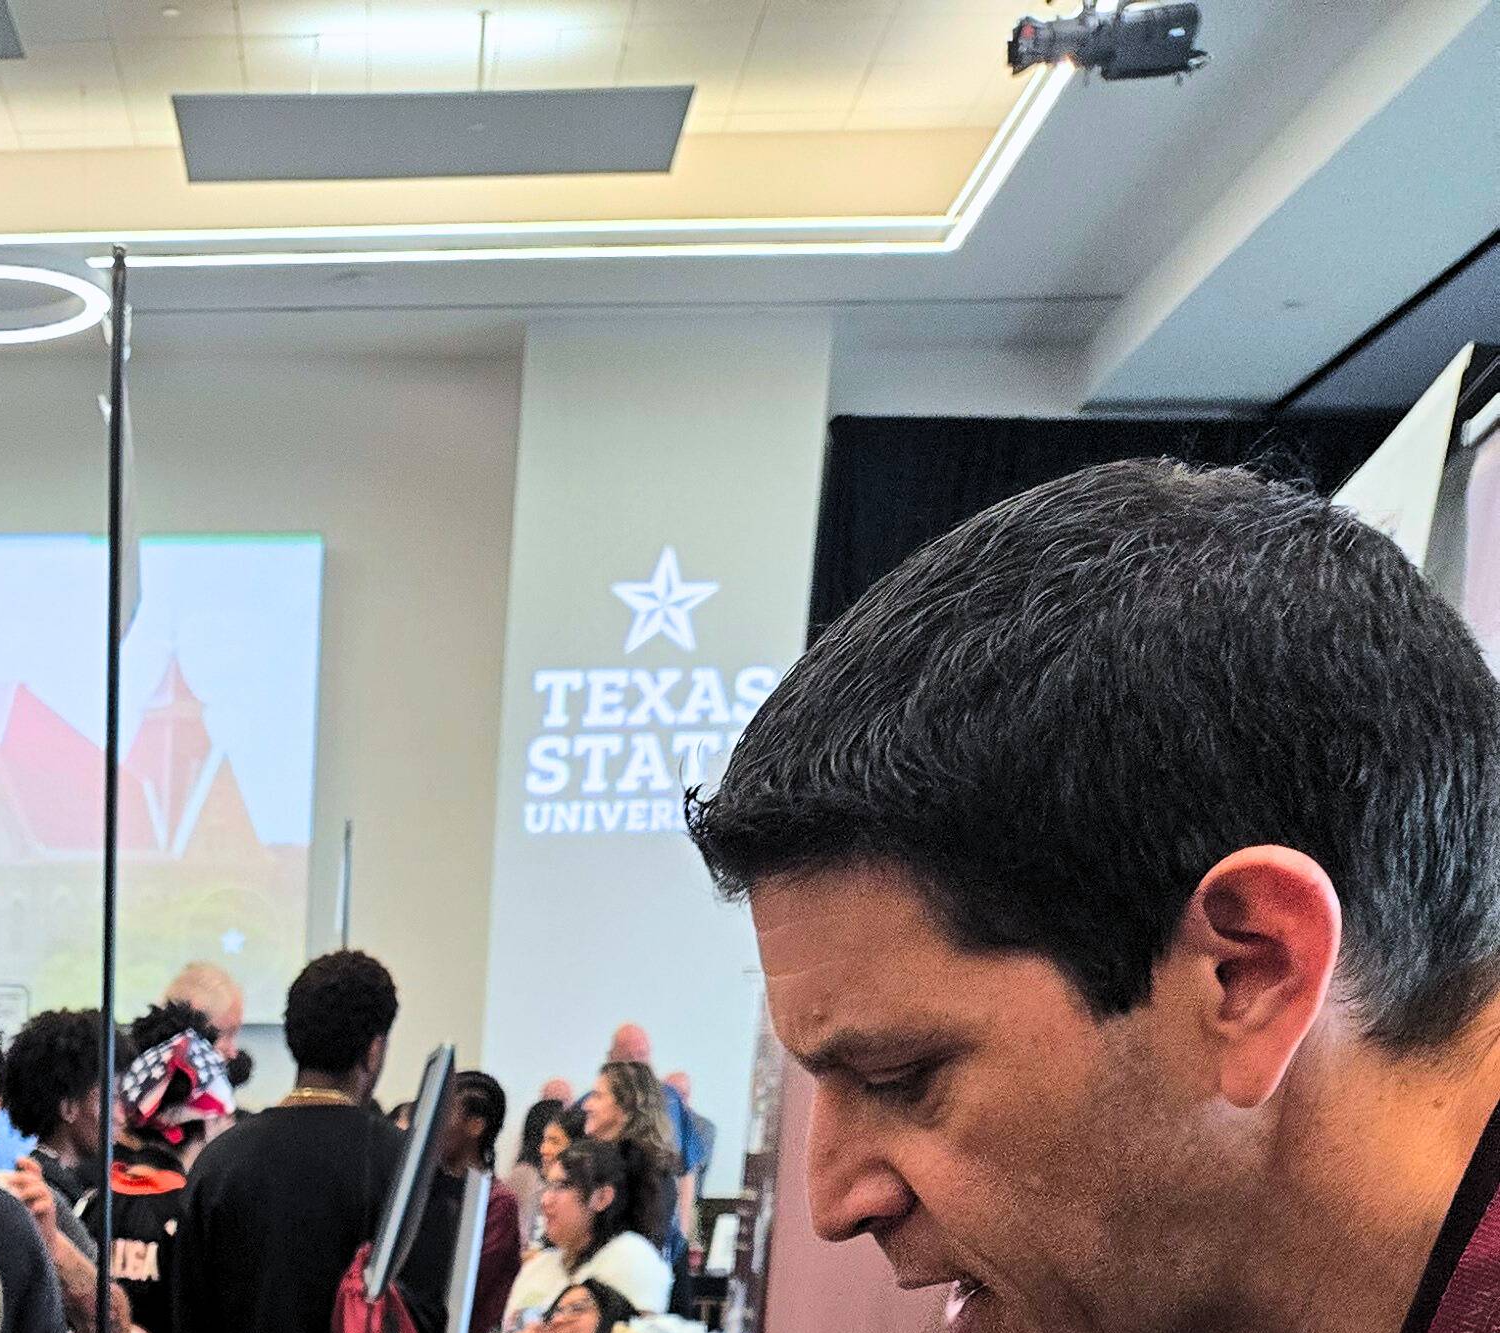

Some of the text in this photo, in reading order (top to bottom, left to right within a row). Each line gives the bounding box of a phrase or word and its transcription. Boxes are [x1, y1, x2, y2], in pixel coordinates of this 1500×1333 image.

[533, 667, 778, 728] TEXAS
[526, 732, 742, 795] STAT
[523, 797, 687, 834] UNIVER
